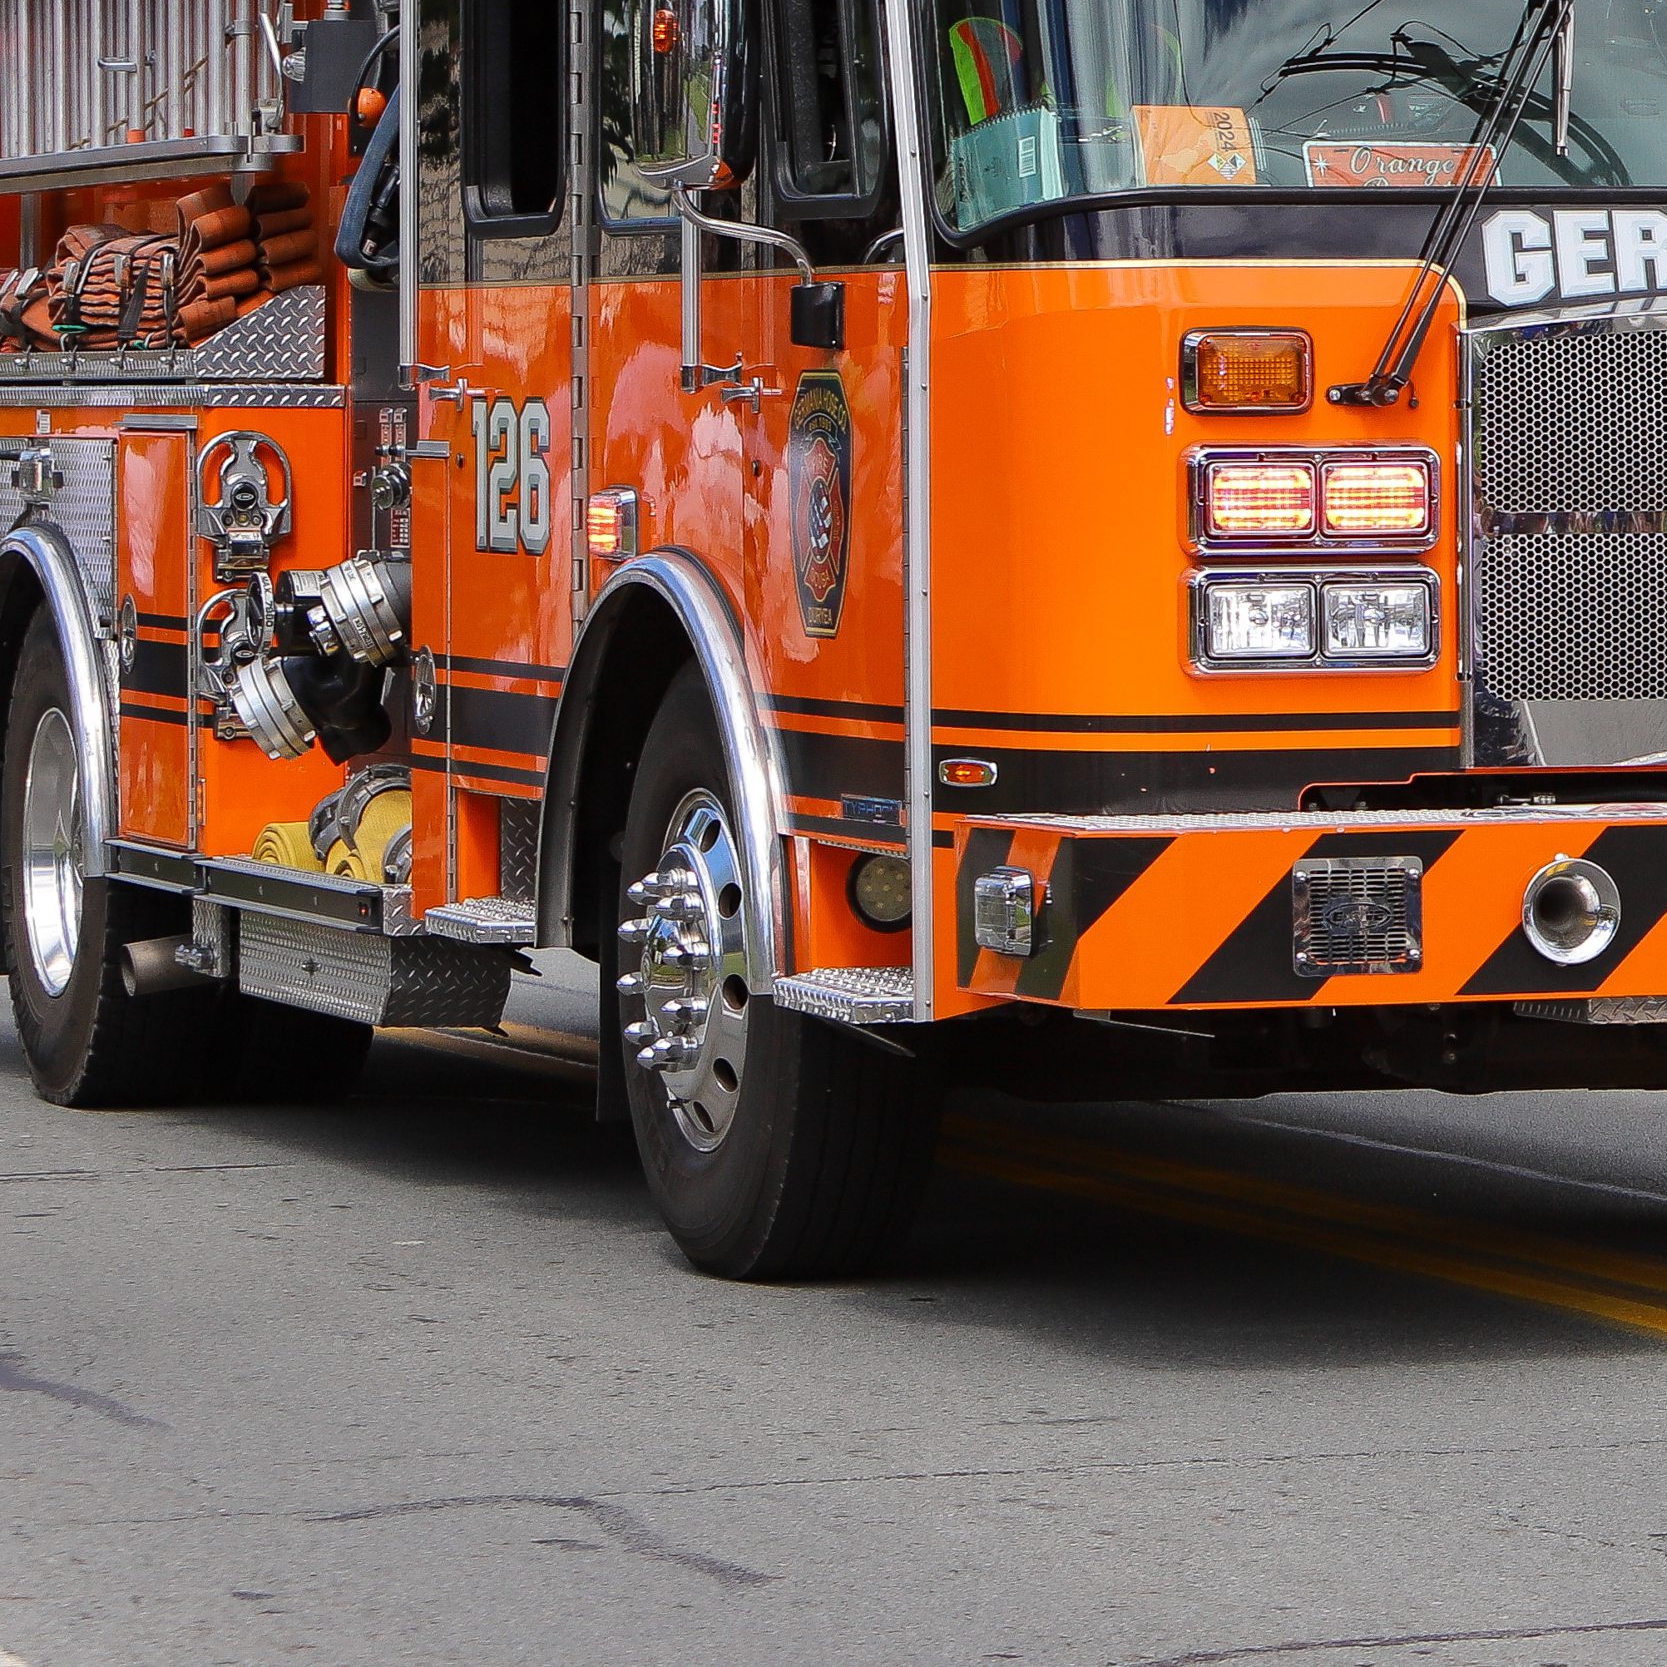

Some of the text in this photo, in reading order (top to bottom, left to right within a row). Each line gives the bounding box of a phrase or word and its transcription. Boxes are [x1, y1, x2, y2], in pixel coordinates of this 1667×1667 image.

[1213, 112, 1236, 153] 2024
[1350, 146, 1456, 186] Orange
[472, 396, 550, 555] 126
